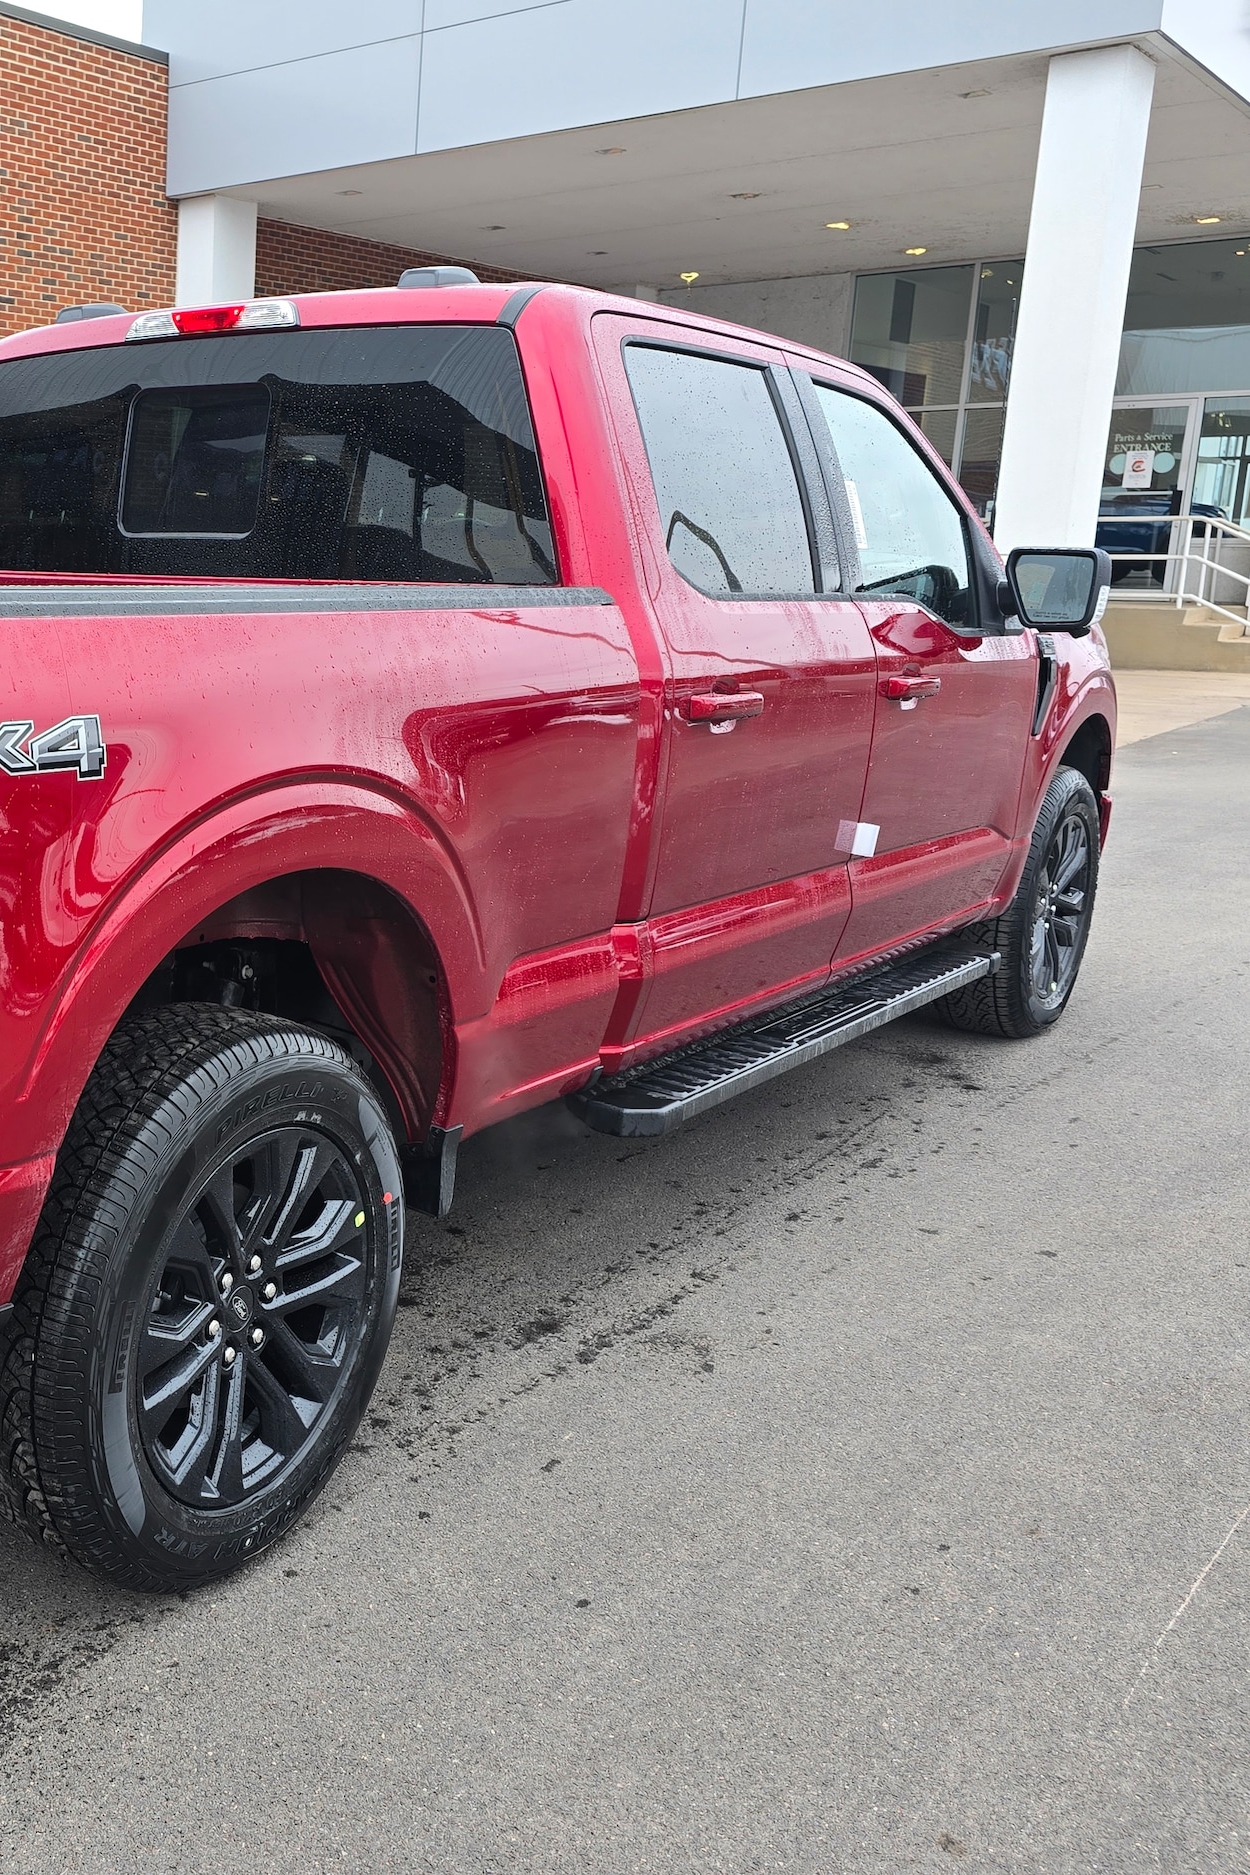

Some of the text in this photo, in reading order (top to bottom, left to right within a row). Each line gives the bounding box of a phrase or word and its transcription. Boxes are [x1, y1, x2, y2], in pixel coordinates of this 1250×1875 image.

[1114, 433, 1135, 442] Parts
[1143, 432, 1173, 441] Service
[1113, 442, 1172, 453] ENTRANCE
[215, 1080, 324, 1145] PIRELLI
